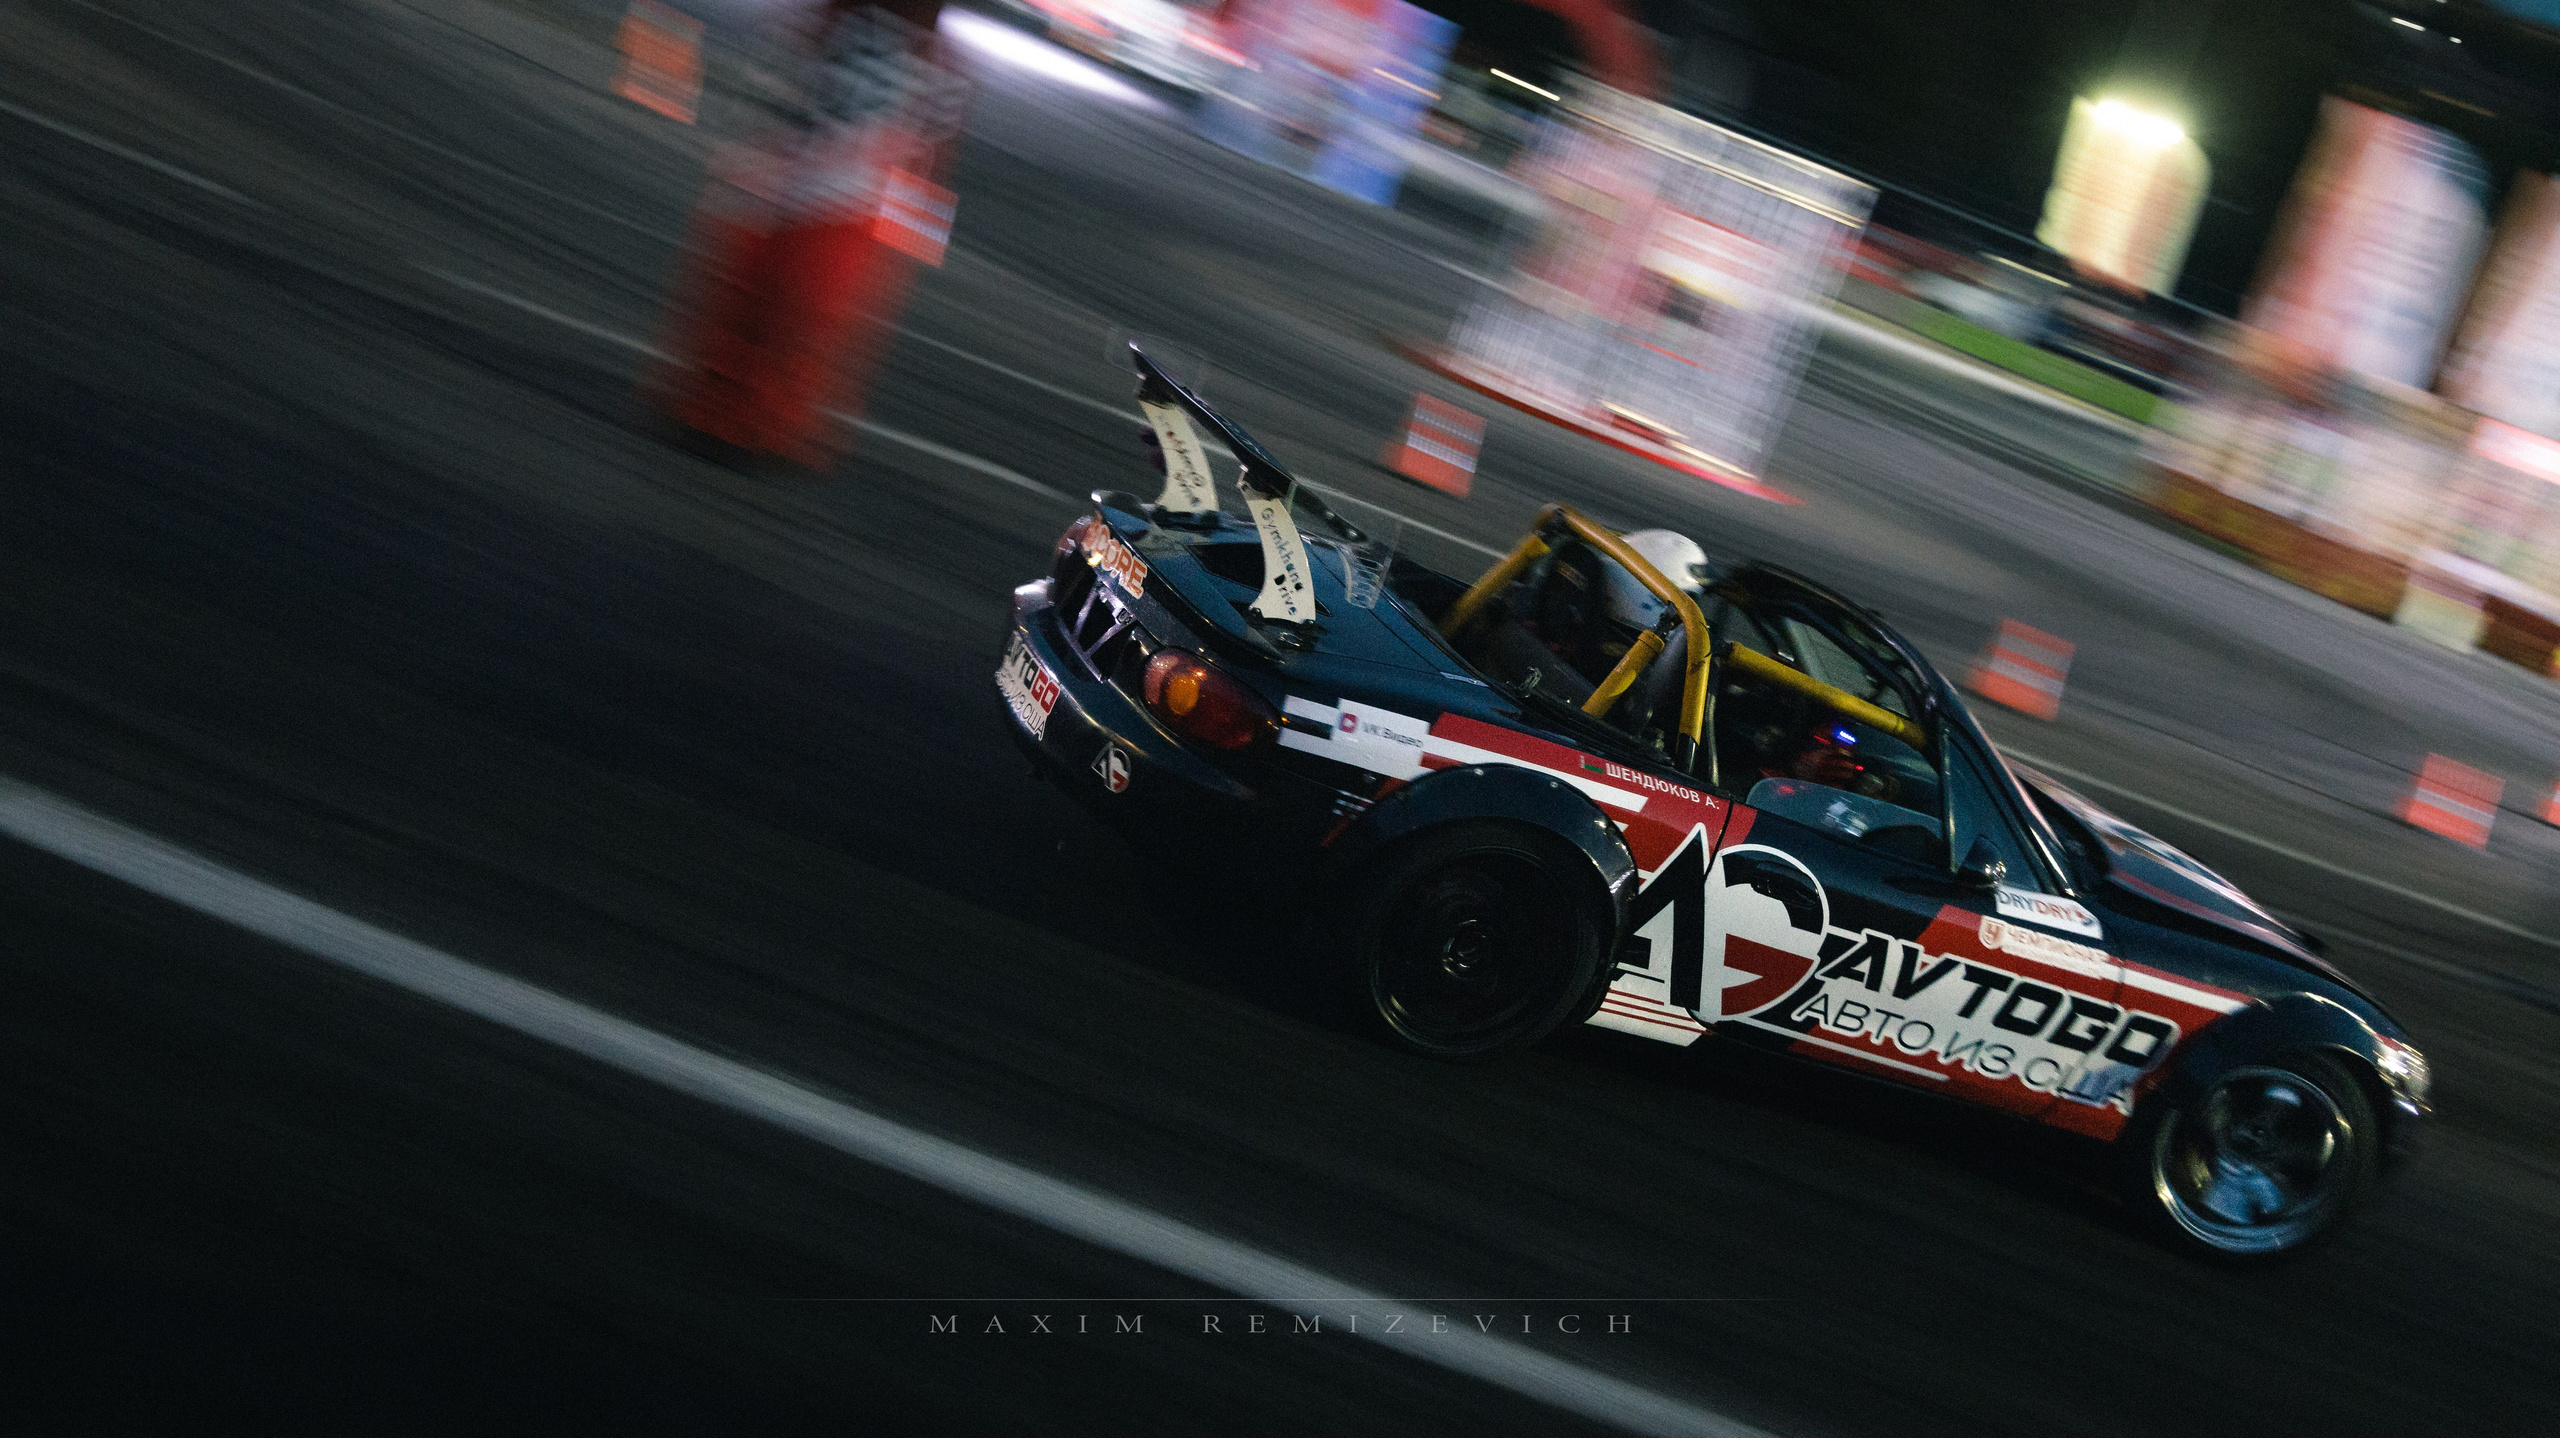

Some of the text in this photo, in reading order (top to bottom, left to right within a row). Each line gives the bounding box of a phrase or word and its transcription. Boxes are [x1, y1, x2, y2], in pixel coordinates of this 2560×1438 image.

[1274, 574, 1297, 616] Drive
[1605, 763, 1701, 803] ШЕНДЮКОВ
[1999, 890, 2073, 922] DRYDRY
[1821, 934, 2174, 1067] AVTOGO
[1799, 993, 1935, 1050] АВТО
[1945, 1030, 2016, 1075] ИЗ
